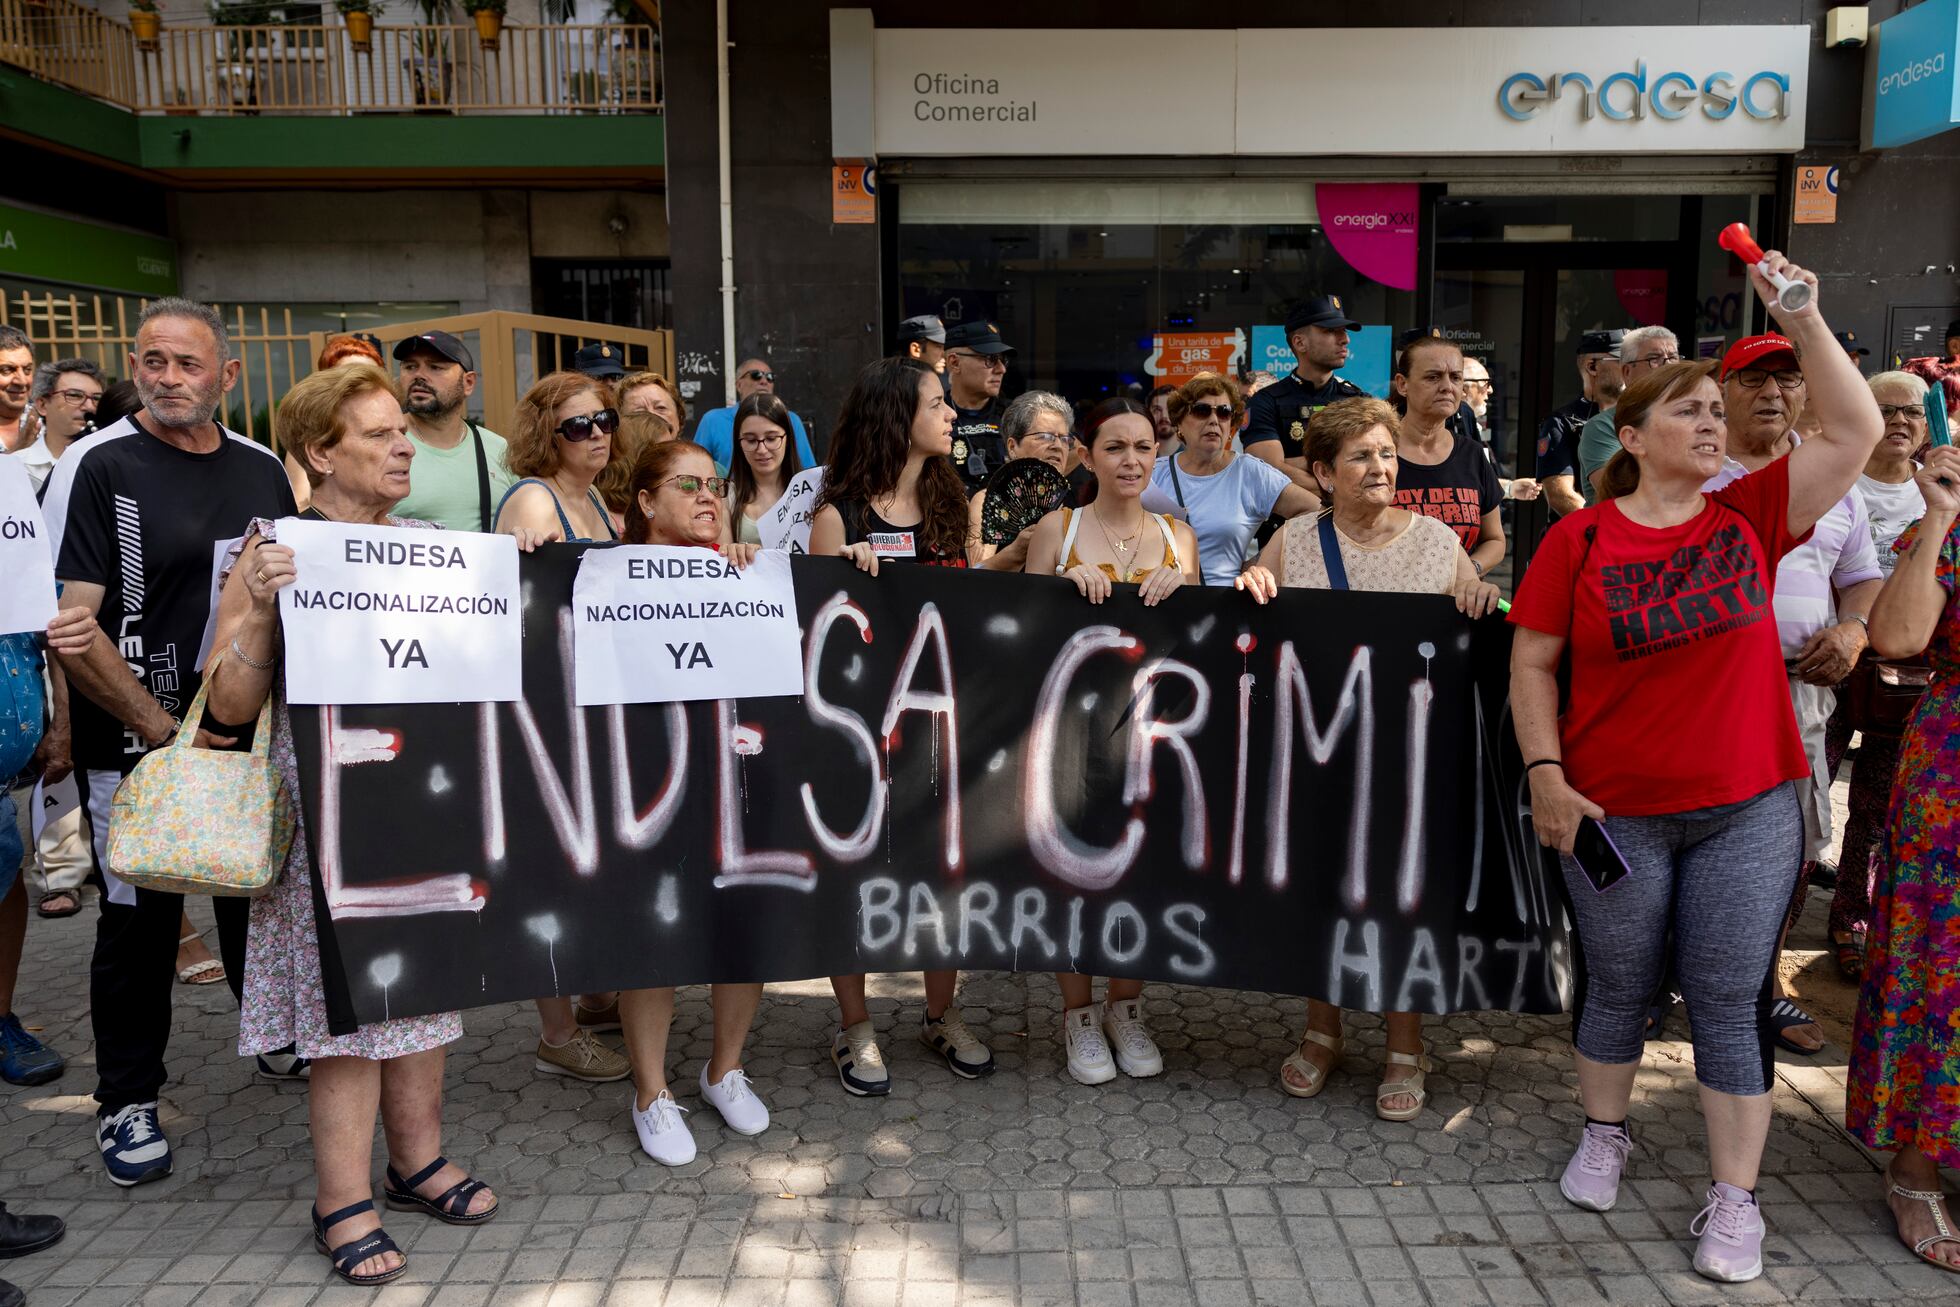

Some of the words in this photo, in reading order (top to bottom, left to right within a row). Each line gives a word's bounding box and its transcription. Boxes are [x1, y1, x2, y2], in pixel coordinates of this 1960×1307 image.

[914, 73, 999, 94] Oficina
[1879, 52, 1945, 95] endesa
[1499, 56, 1792, 121] endesa
[914, 100, 1036, 122] Comercial
[1210, 336, 1222, 347] de
[1181, 348, 1211, 364] gas
[1429, 488, 1455, 504] DE
[1456, 488, 1480, 505] UN
[345, 539, 467, 569] ENDESA
[1602, 560, 1667, 587] SOY
[1670, 545, 1703, 569] DE
[628, 558, 741, 580] ENDESA
[294, 589, 508, 615] NACIONALIZACIÓN
[587, 600, 785, 622] NACIONALIZACIÓN
[380, 638, 429, 669] YA
[665, 642, 713, 670] YA
[317, 591, 963, 921] ENDESA
[859, 876, 1216, 979] BARRIOS
